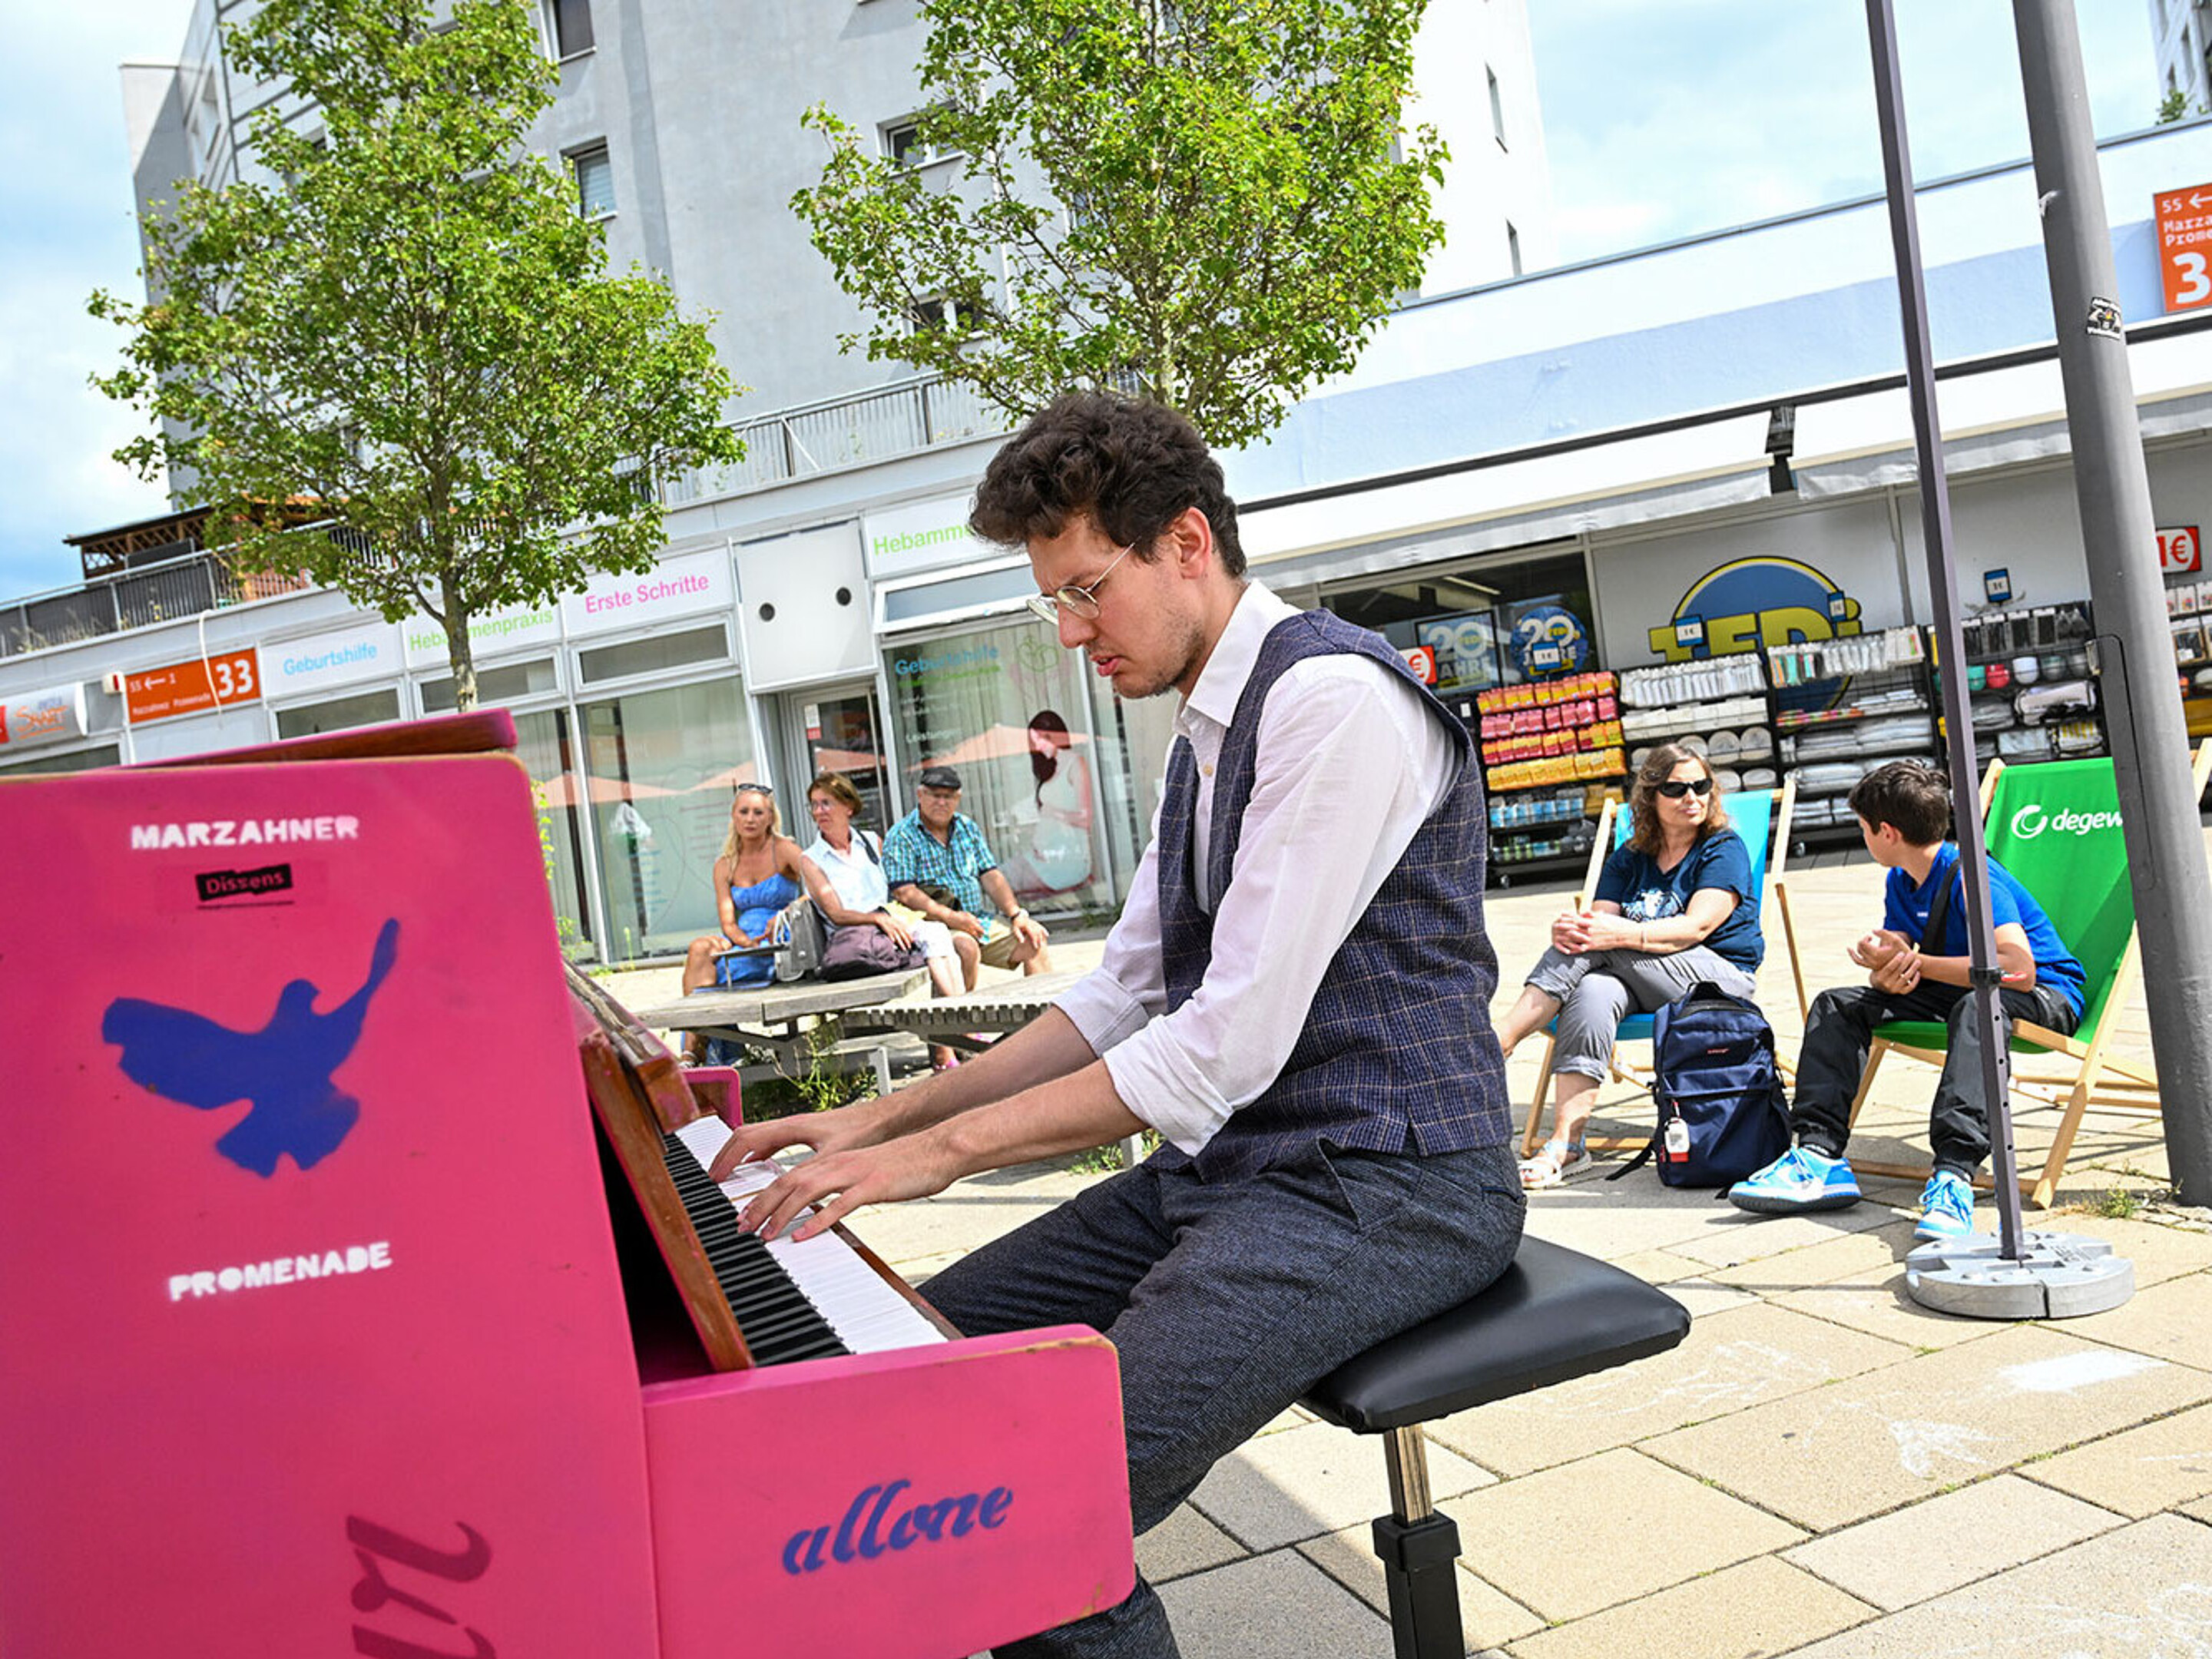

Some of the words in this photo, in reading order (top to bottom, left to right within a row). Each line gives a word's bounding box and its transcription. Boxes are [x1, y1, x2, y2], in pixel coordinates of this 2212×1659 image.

[584, 591, 634, 614] Erste
[636, 573, 710, 604] Schritte
[283, 642, 378, 676] Geburtshilfe
[215, 659, 253, 698] 33
[131, 815, 360, 849] MARZAHNER
[205, 869, 286, 896] Dissens
[168, 1240, 393, 1302] PROMENADE
